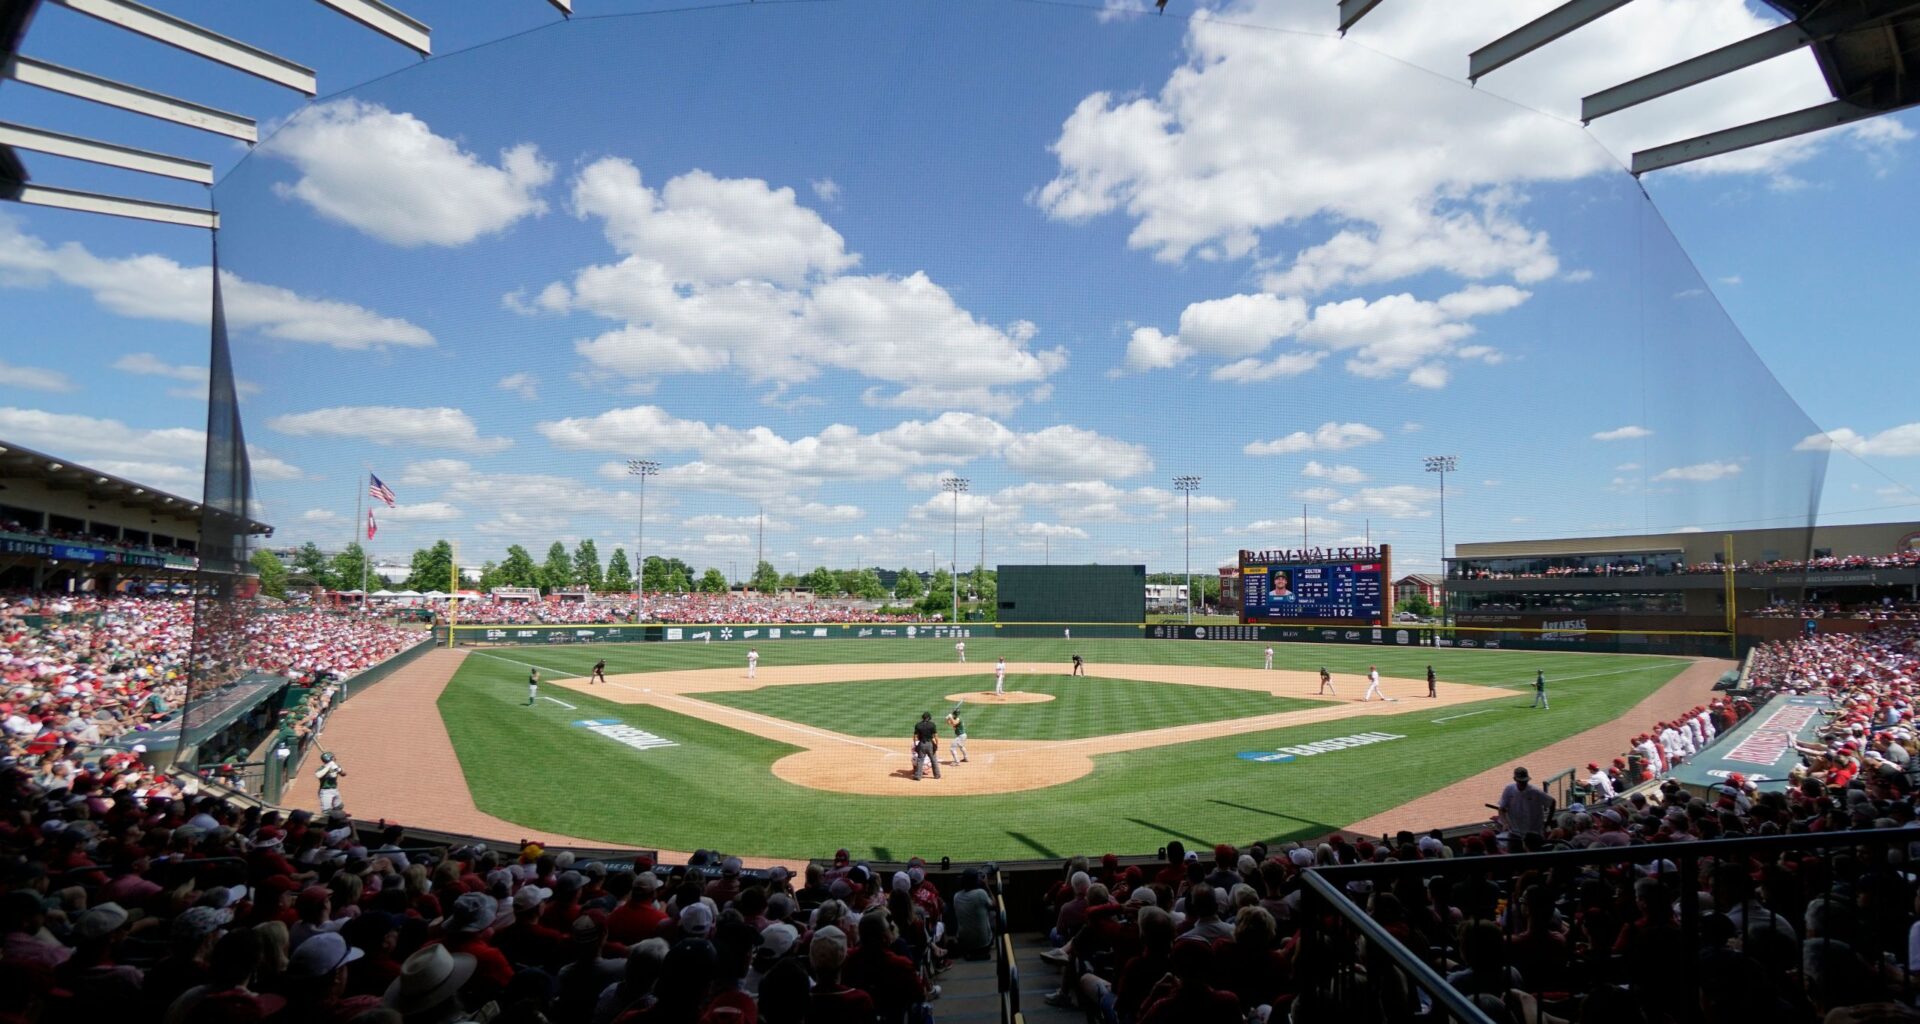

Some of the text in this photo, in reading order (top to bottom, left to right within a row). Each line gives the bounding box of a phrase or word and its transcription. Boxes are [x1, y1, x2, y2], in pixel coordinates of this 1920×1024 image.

[1247, 546, 1377, 562] BAUM-WALKER
[1333, 609, 1338, 617] 1
[1339, 609, 1346, 617] 0
[1347, 609, 1353, 617] 2
[1542, 618, 1588, 632] ARKANSAS
[1276, 731, 1407, 756] BASEBALL
